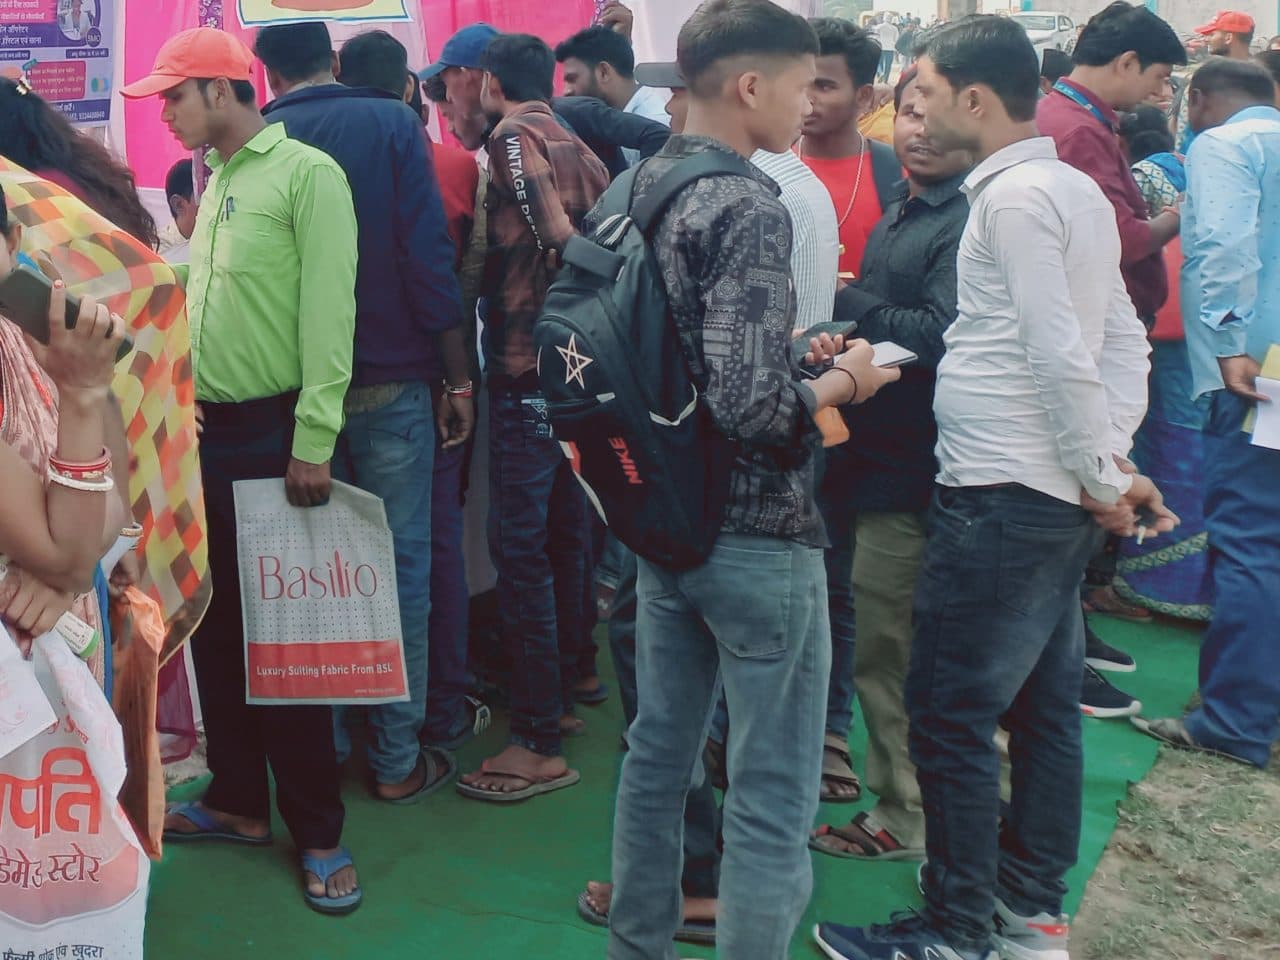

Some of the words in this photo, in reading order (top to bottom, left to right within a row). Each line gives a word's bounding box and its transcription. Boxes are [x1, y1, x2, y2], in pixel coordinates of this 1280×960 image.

[505, 135, 527, 201] VINTAGE
[257, 550, 378, 600] Basilio
[256, 665, 287, 679] Luxury
[288, 665, 319, 677] Suiting
[321, 664, 349, 676] Fabric
[351, 663, 374, 675] From
[376, 662, 393, 674] BSL
[46, 842, 103, 884] स्टोर
